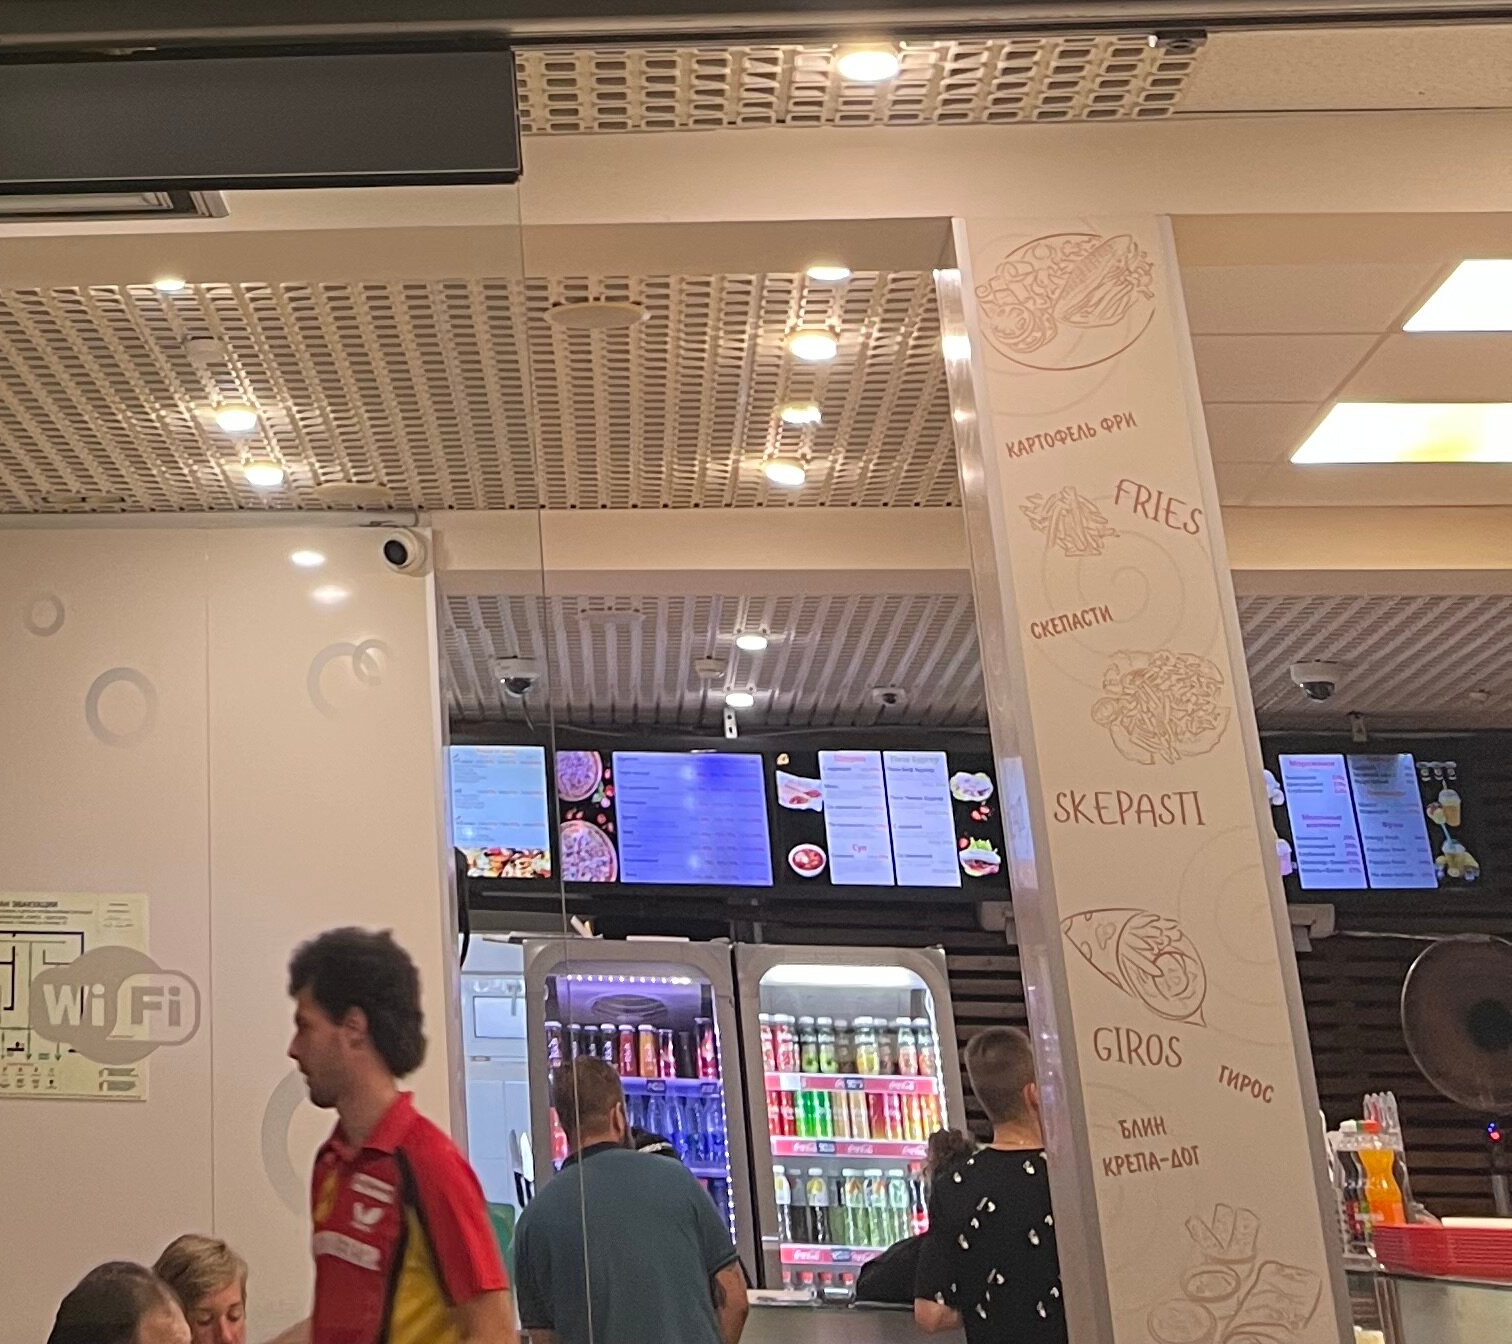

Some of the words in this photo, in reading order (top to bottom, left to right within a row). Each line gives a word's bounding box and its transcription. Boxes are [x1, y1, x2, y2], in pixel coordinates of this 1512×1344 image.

[1004, 421, 1097, 459] КАРТОФЕЛЬ
[1099, 410, 1138, 436] ФРИ
[1113, 477, 1204, 537] FRIES
[1029, 604, 1115, 641] СКЕПАСТИ
[1052, 788, 1207, 829] SKEPASTI
[1092, 1026, 1183, 1068] GIROS
[1218, 1063, 1275, 1105] ГИРОС
[1117, 1115, 1168, 1138] БЛИН
[1102, 1145, 1200, 1177] КРЕПА-ДОГ
